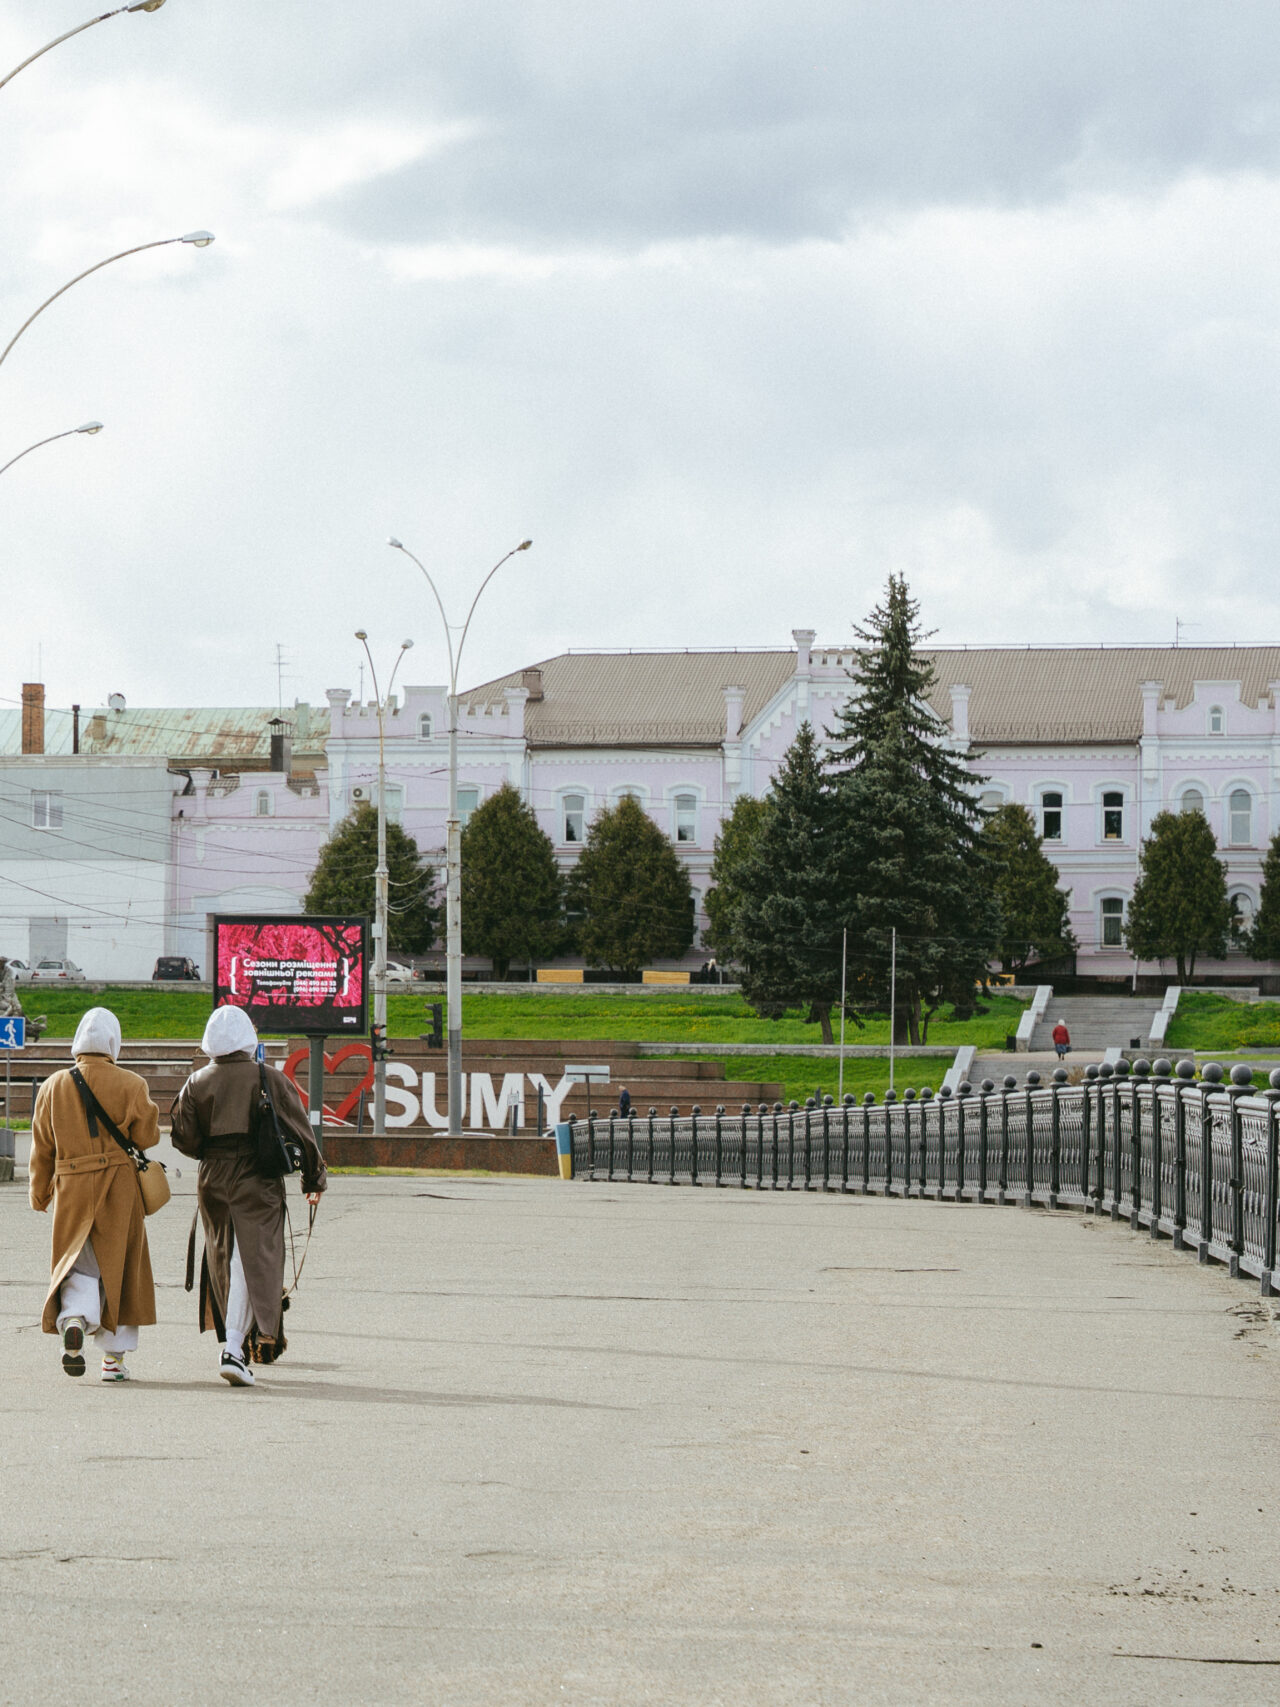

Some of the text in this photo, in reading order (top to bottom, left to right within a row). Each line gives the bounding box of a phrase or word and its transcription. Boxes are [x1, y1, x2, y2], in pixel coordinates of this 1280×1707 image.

[243, 958, 337, 970] Сезони розміщення
[243, 968, 337, 979] зовнішньої реклами
[368, 1062, 575, 1128] SUMY
